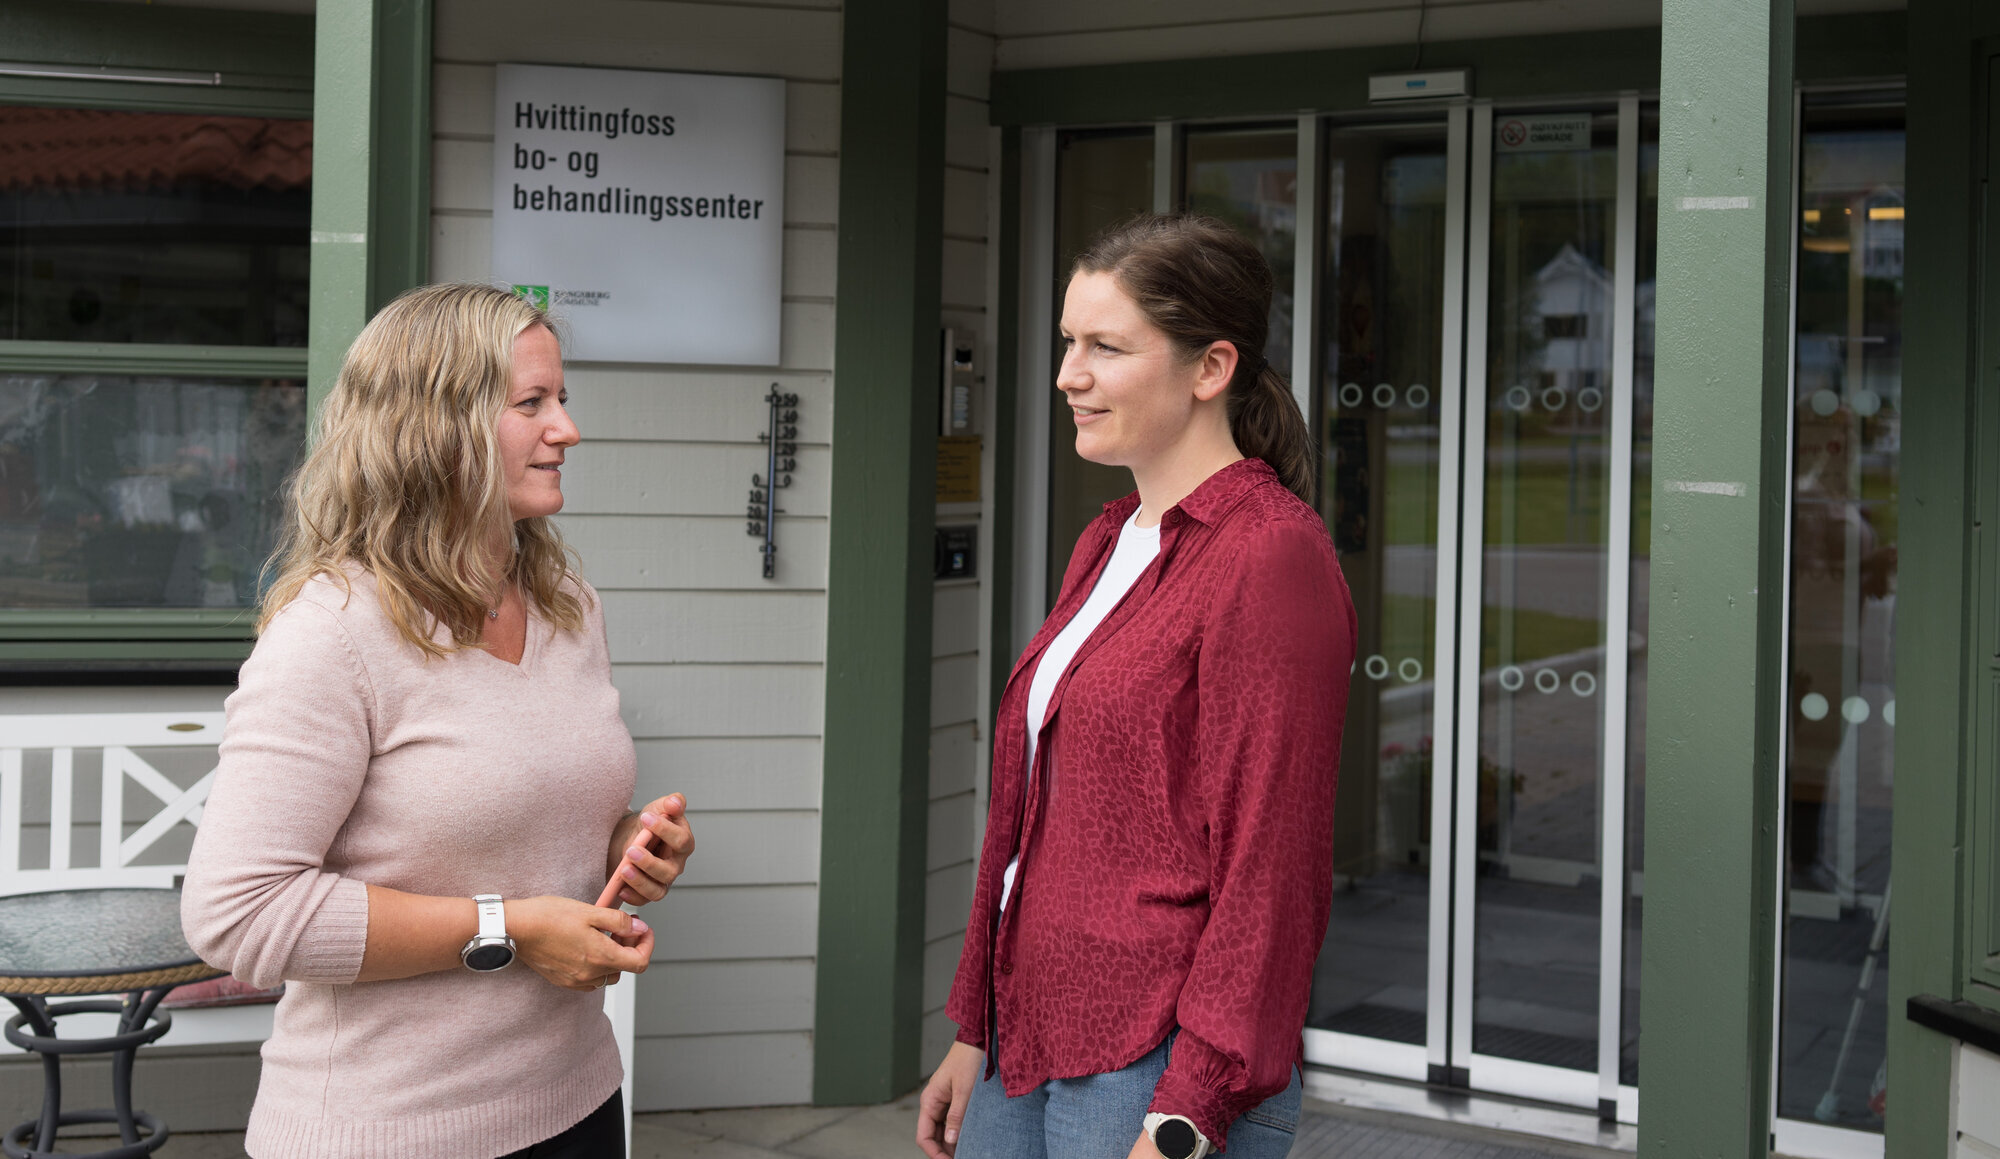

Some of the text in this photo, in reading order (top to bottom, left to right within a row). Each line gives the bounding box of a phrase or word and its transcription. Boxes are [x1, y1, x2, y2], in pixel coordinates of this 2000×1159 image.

[514, 101, 676, 140] Hvittingfoss
[514, 142, 599, 179] bo- og
[513, 183, 764, 222] behandlingssenter
[783, 393, 798, 407] 50
[783, 409, 798, 423] 40
[782, 425, 797, 439] 30
[782, 442, 797, 456] 20
[783, 458, 796, 471] 10
[752, 473, 760, 486] 0
[783, 474, 792, 487] 0
[749, 489, 762, 503] 10
[747, 505, 762, 519] 20
[746, 521, 761, 536] 30
